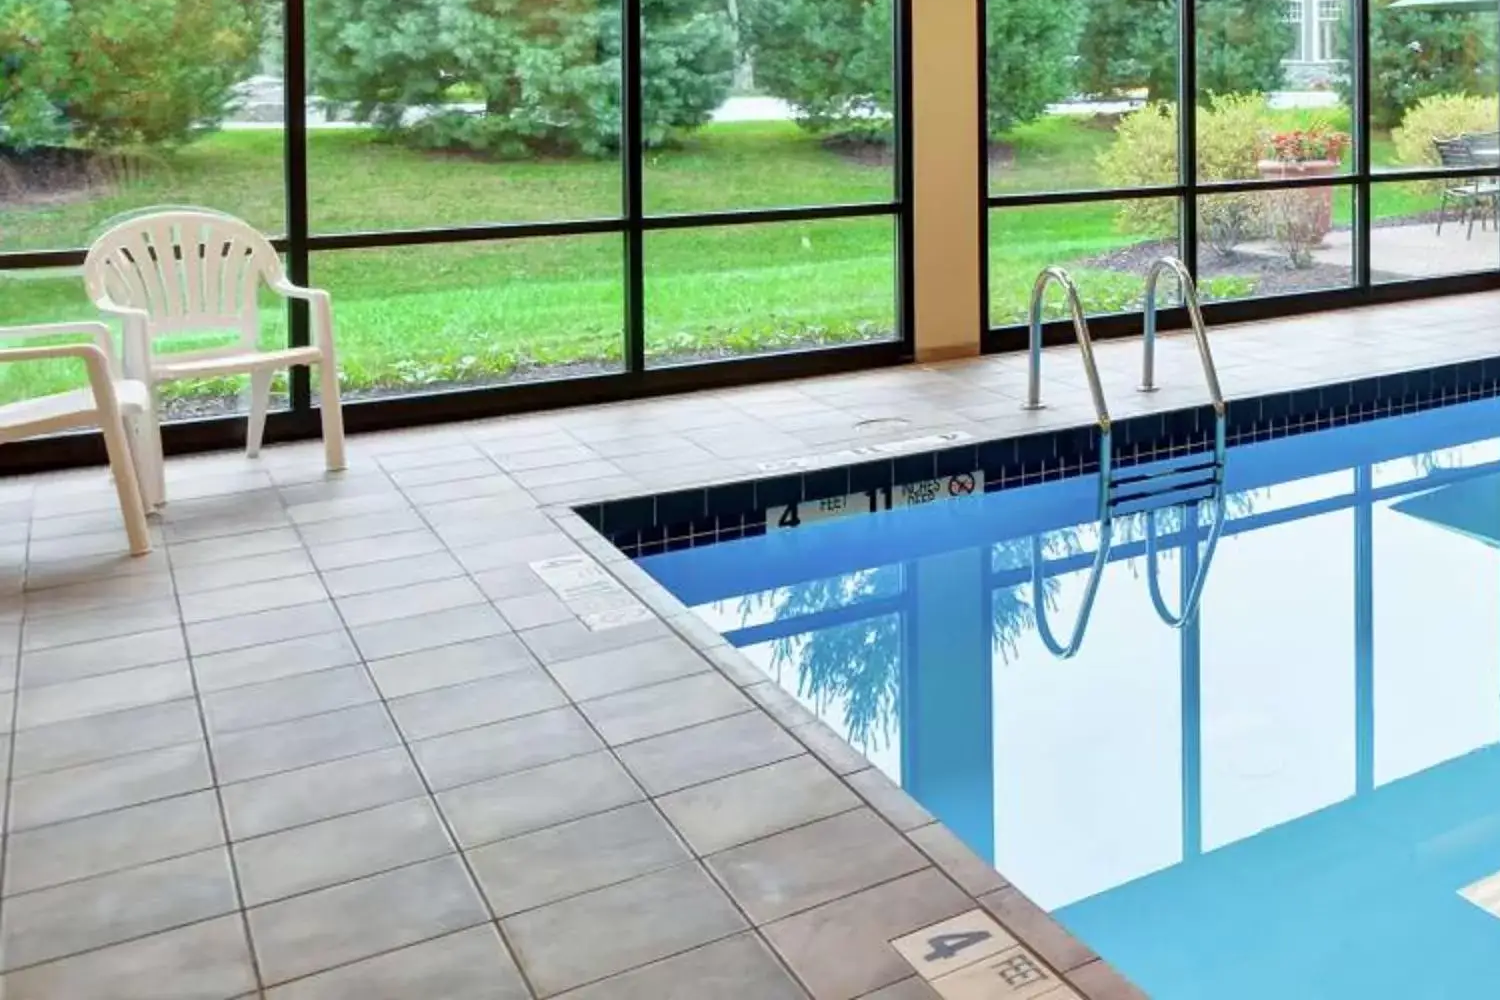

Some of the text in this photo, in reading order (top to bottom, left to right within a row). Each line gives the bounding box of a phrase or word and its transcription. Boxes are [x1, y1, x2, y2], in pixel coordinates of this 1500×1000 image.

[778, 502, 801, 528] 4
[819, 496, 847, 512] FEET
[865, 486, 893, 513] 11
[923, 930, 1049, 991] 4 FEET
